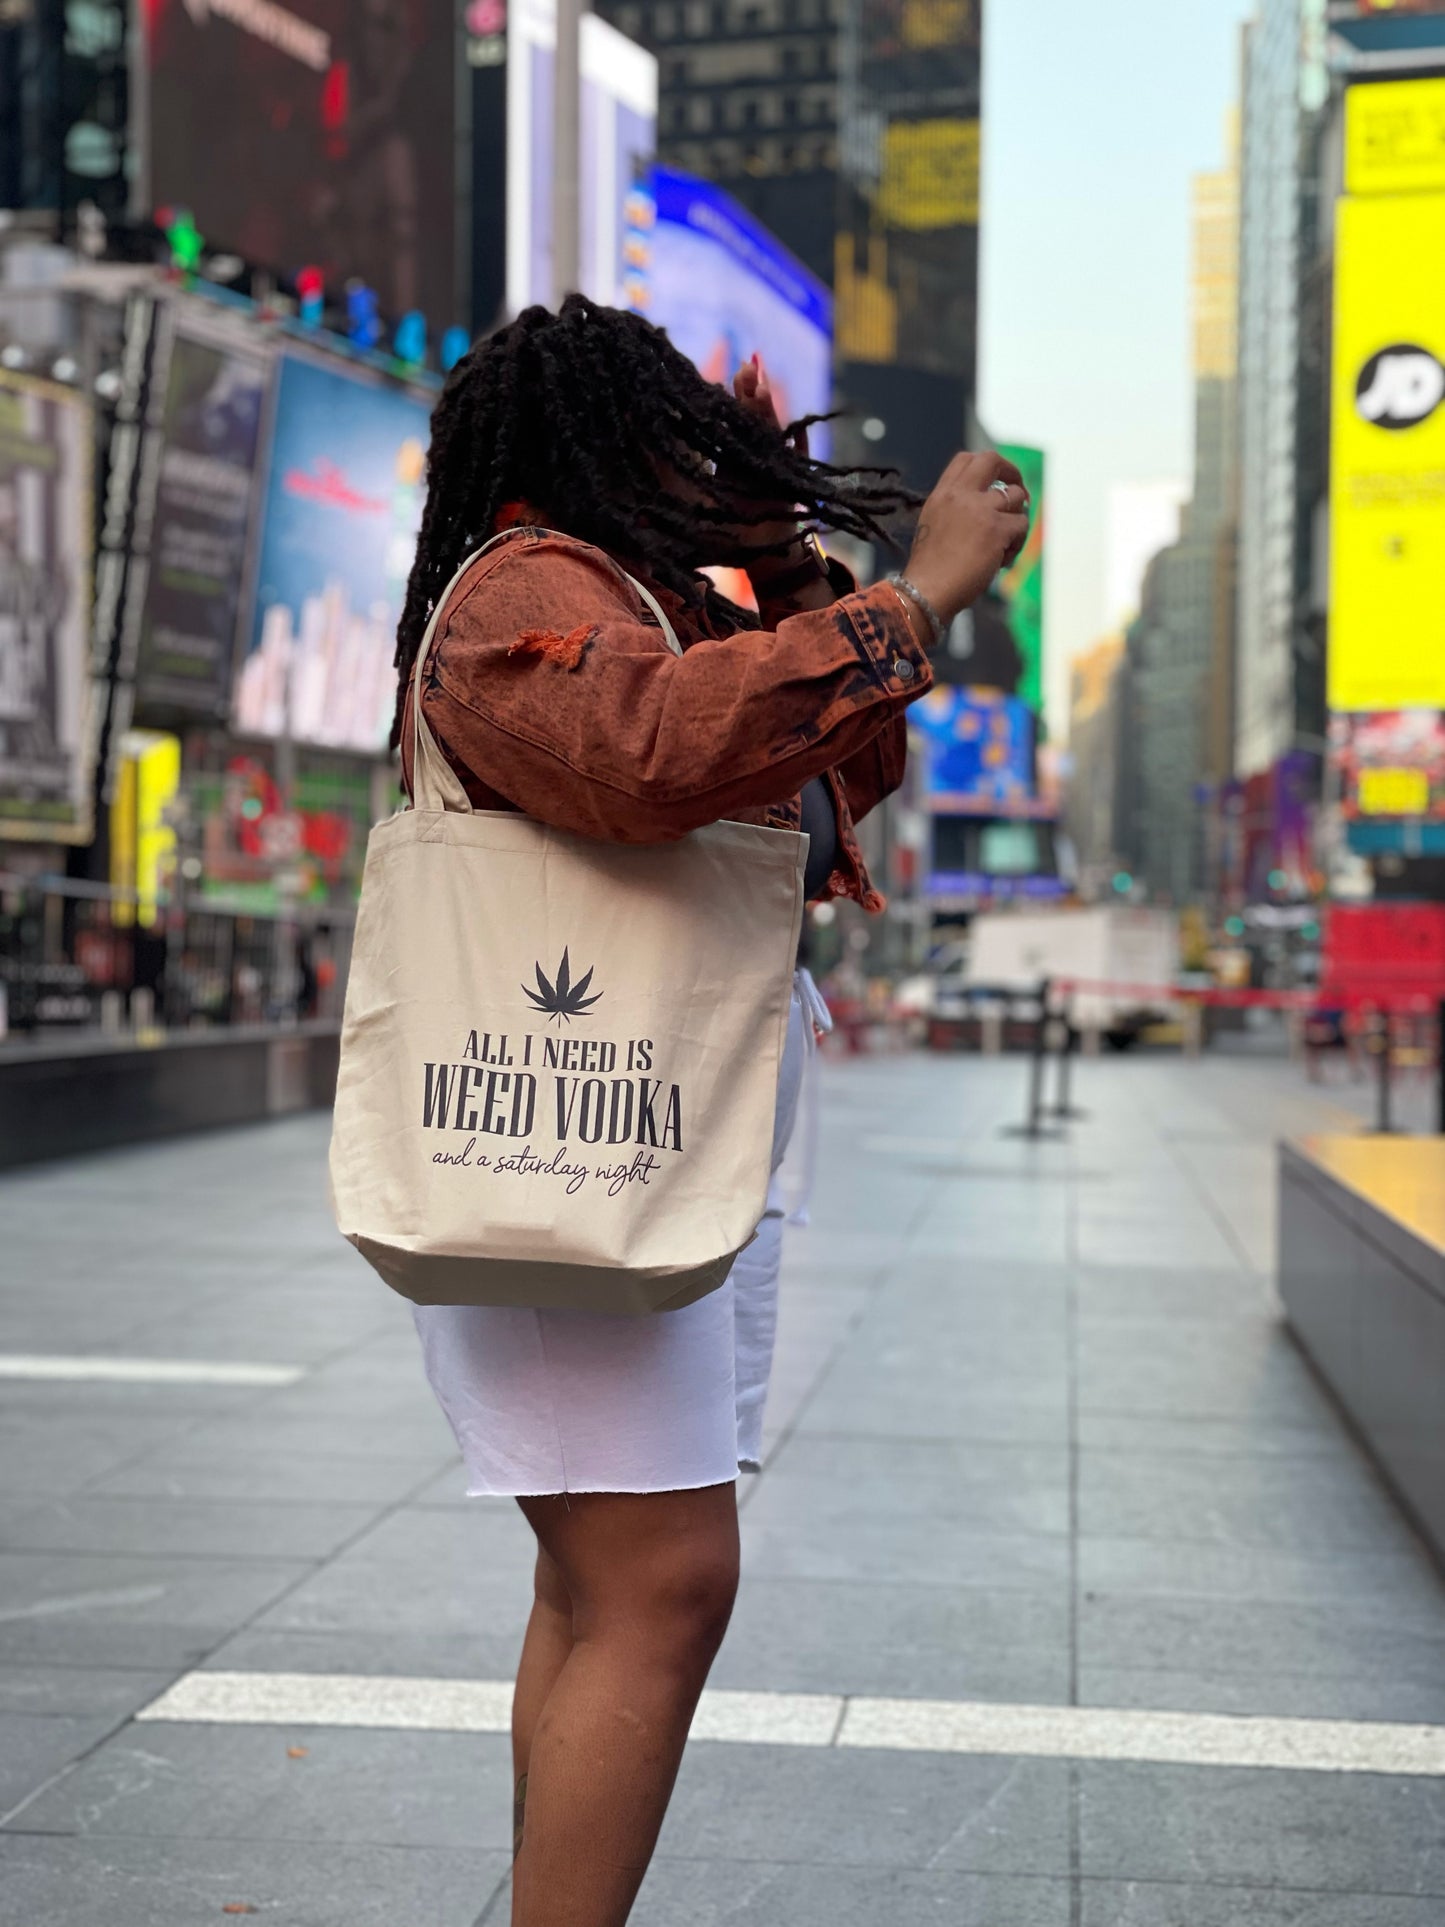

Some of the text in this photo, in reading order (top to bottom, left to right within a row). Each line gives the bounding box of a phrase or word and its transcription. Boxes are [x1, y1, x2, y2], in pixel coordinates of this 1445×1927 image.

[462, 1029, 655, 1073] ALL I NEED IS
[423, 1062, 684, 1152] WEED VODKA
[432, 1137, 661, 1197] and a saturday night
